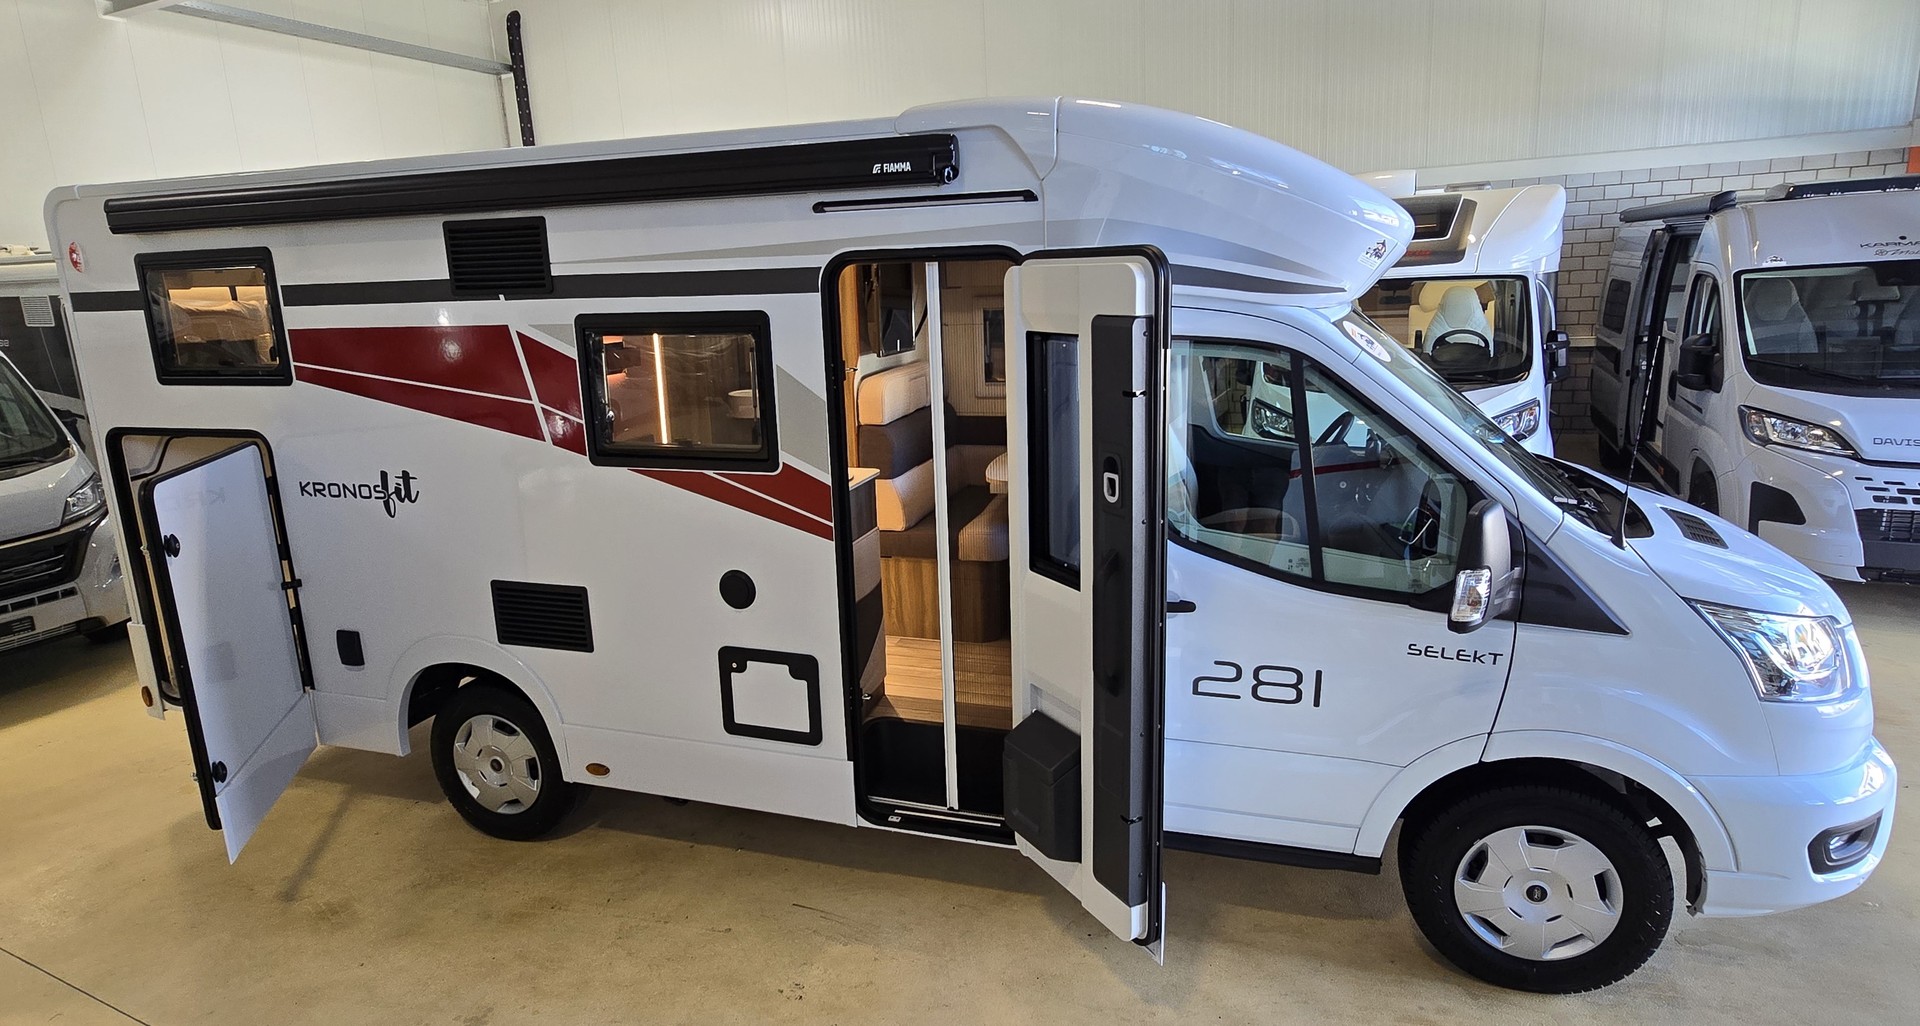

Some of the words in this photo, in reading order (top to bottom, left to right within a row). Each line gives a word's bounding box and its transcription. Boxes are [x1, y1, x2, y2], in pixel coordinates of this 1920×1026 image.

[883, 161, 912, 173] FIAMMA
[1407, 643, 1504, 666] SELEKT
[1192, 660, 1323, 708] 281
